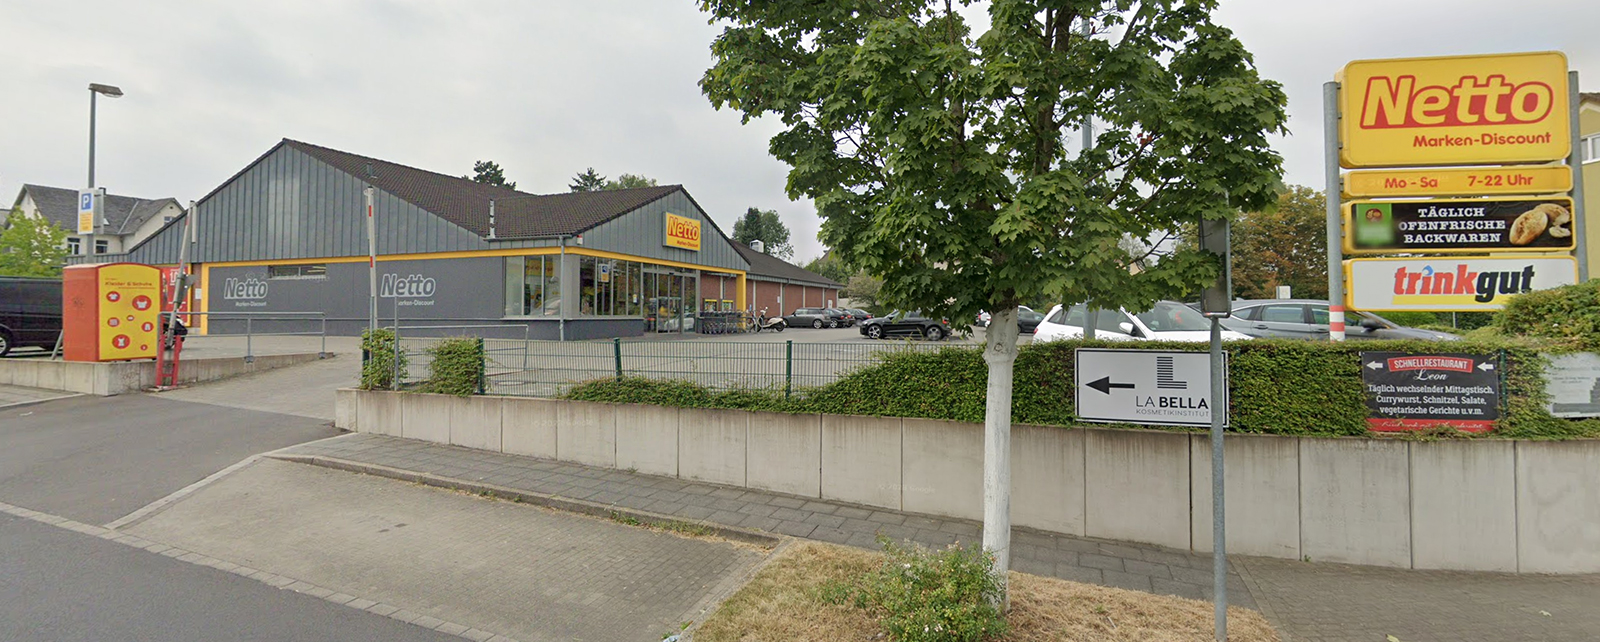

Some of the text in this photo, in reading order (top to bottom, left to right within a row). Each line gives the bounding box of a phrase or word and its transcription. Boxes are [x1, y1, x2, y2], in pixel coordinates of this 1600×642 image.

[1360, 75, 1554, 129] Netto
[1412, 132, 1551, 148] Marken-Discount
[1384, 178, 1407, 189] Mo
[1420, 177, 1438, 188] Sa
[1468, 175, 1503, 187] 7-22
[1507, 174, 1533, 186] Uhr
[83, 195, 90, 208] P
[1418, 206, 1485, 218] TÄGLICH
[668, 216, 699, 241] Netto
[1399, 220, 1506, 231] OFENFRISCHE
[1404, 233, 1501, 244] BACKWAREN
[224, 278, 268, 299] Netto
[380, 273, 436, 298] Netto
[1393, 264, 1535, 303] trinkgut
[1394, 359, 1468, 370] SCHNELLRESTAURANT
[1413, 369, 1448, 381] Leon
[1368, 385, 1494, 396] Täglich wechselnder Mittagstisch,
[1136, 396, 1208, 409] LA BELLA
[1376, 395, 1486, 406] Currywurst, Schnitzel, Salate,
[1136, 409, 1208, 417] KOSMETIKINSTITUT
[1379, 407, 1428, 415] vegetarische
[1429, 406, 1460, 415] Gerichte
